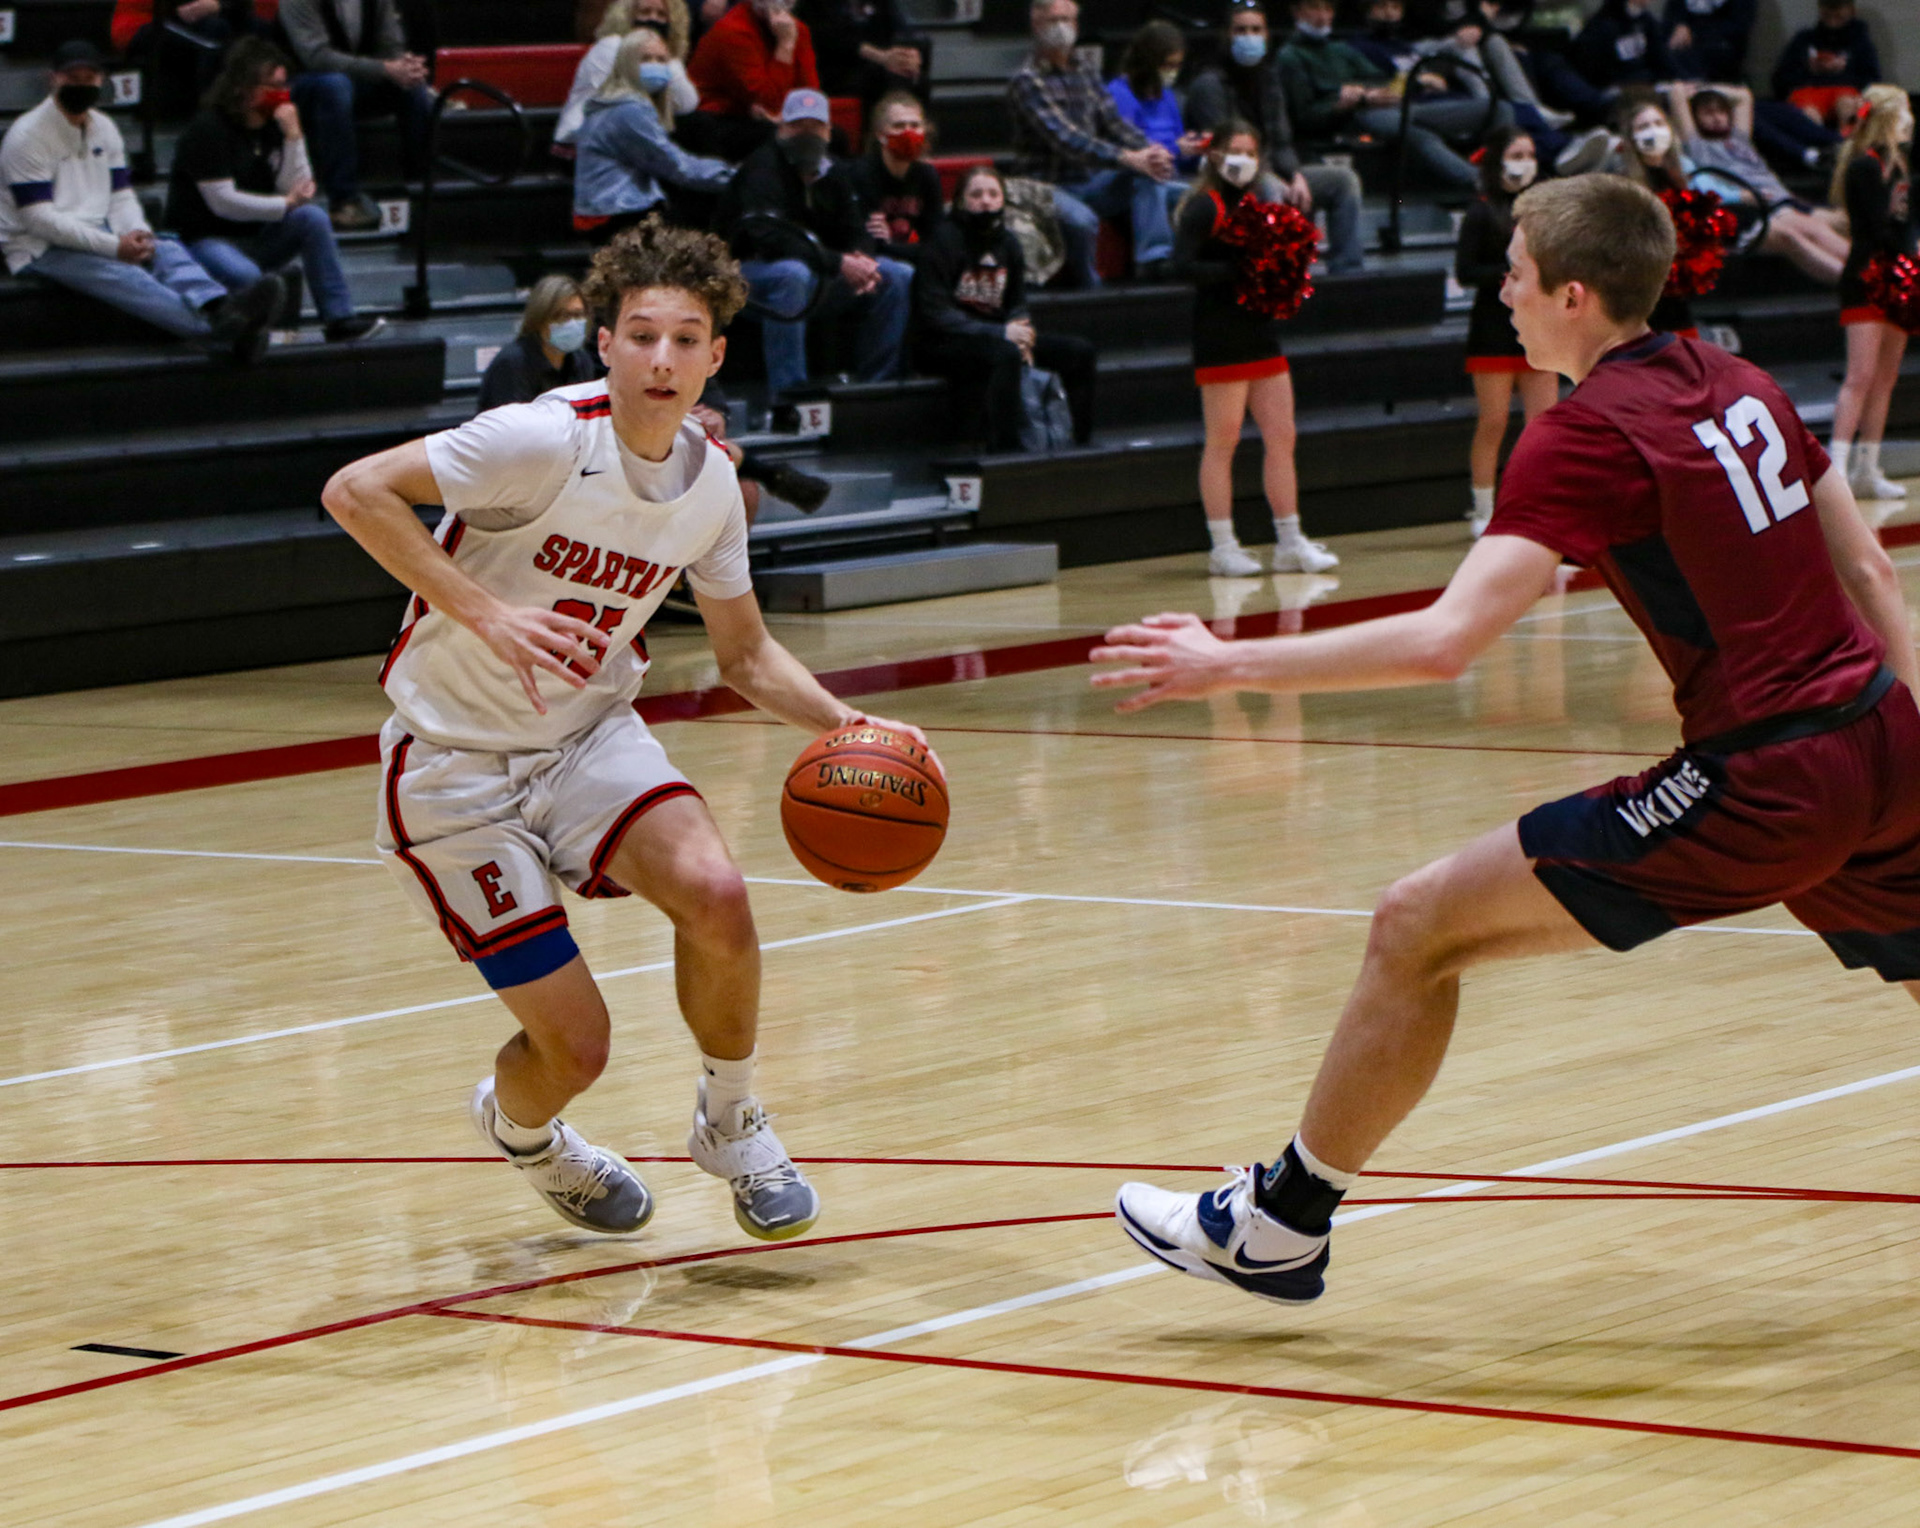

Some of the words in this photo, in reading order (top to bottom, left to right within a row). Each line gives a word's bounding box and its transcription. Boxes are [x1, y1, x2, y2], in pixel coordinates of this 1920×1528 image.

[1691, 395, 1810, 535] 12
[816, 763, 928, 807] SPALDING
[471, 860, 518, 919] E
